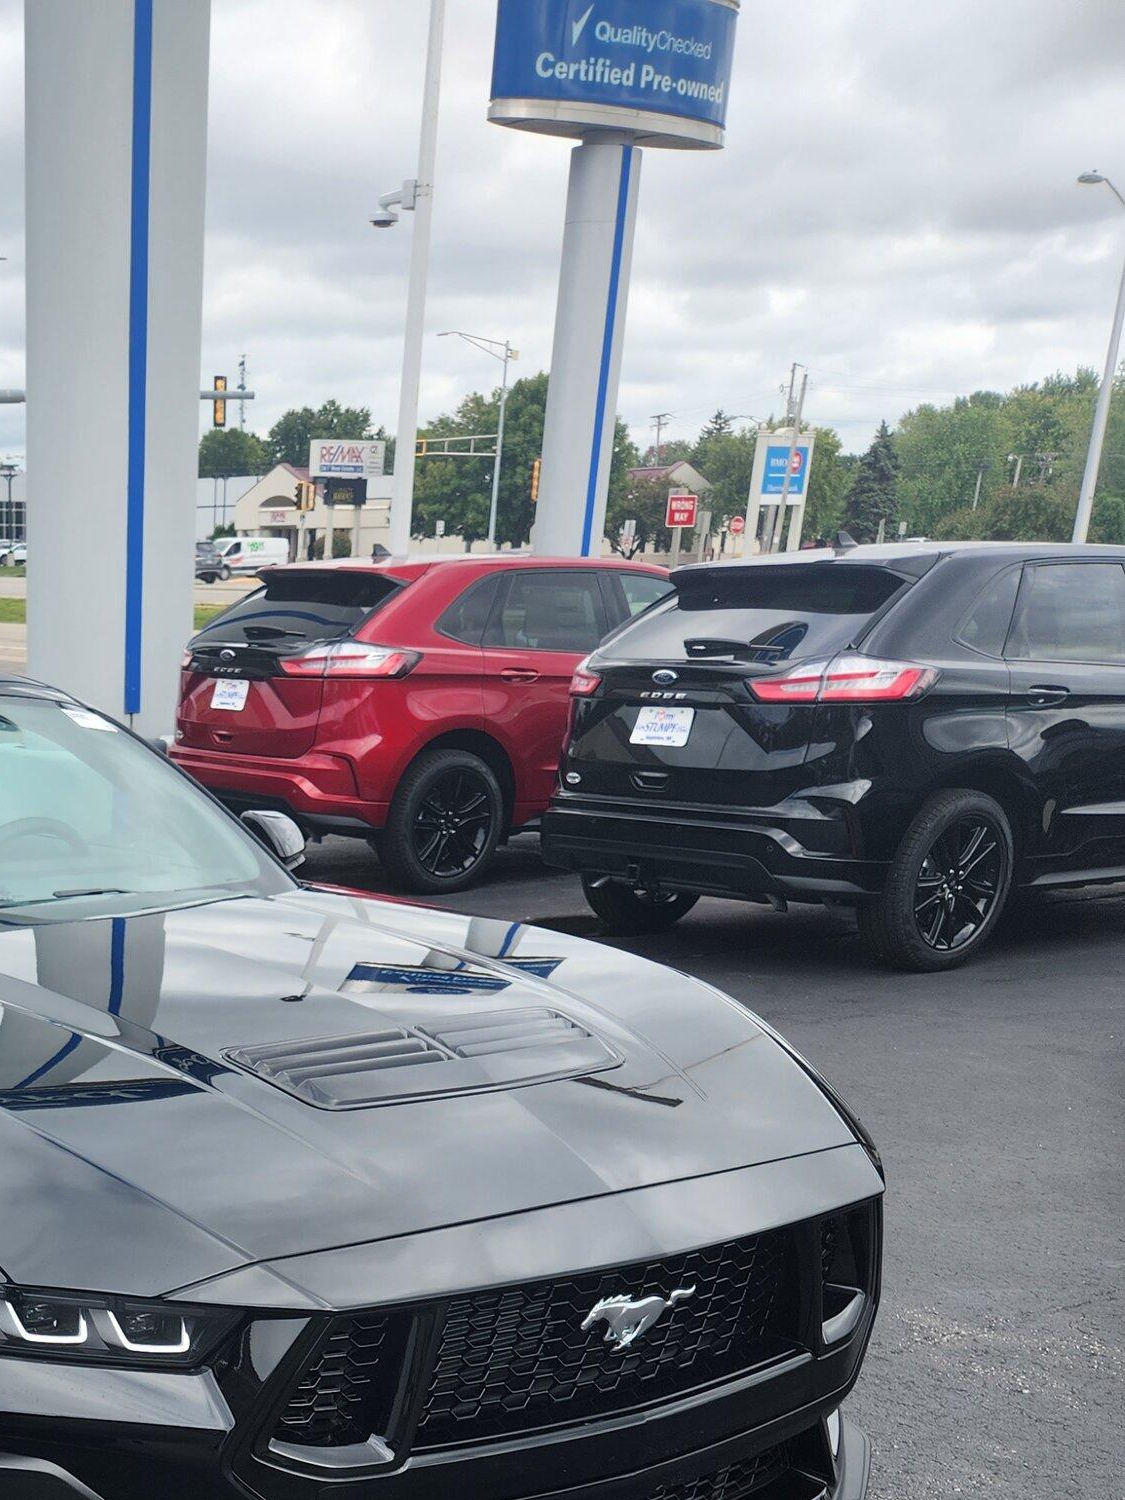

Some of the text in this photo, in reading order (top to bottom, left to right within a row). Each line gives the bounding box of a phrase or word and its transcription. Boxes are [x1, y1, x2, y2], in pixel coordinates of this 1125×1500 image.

[595, 21, 712, 60] QualityChecked
[535, 52, 724, 104] Certified Pre-owned
[671, 501, 694, 511] WRONG
[674, 512, 688, 521] WAY
